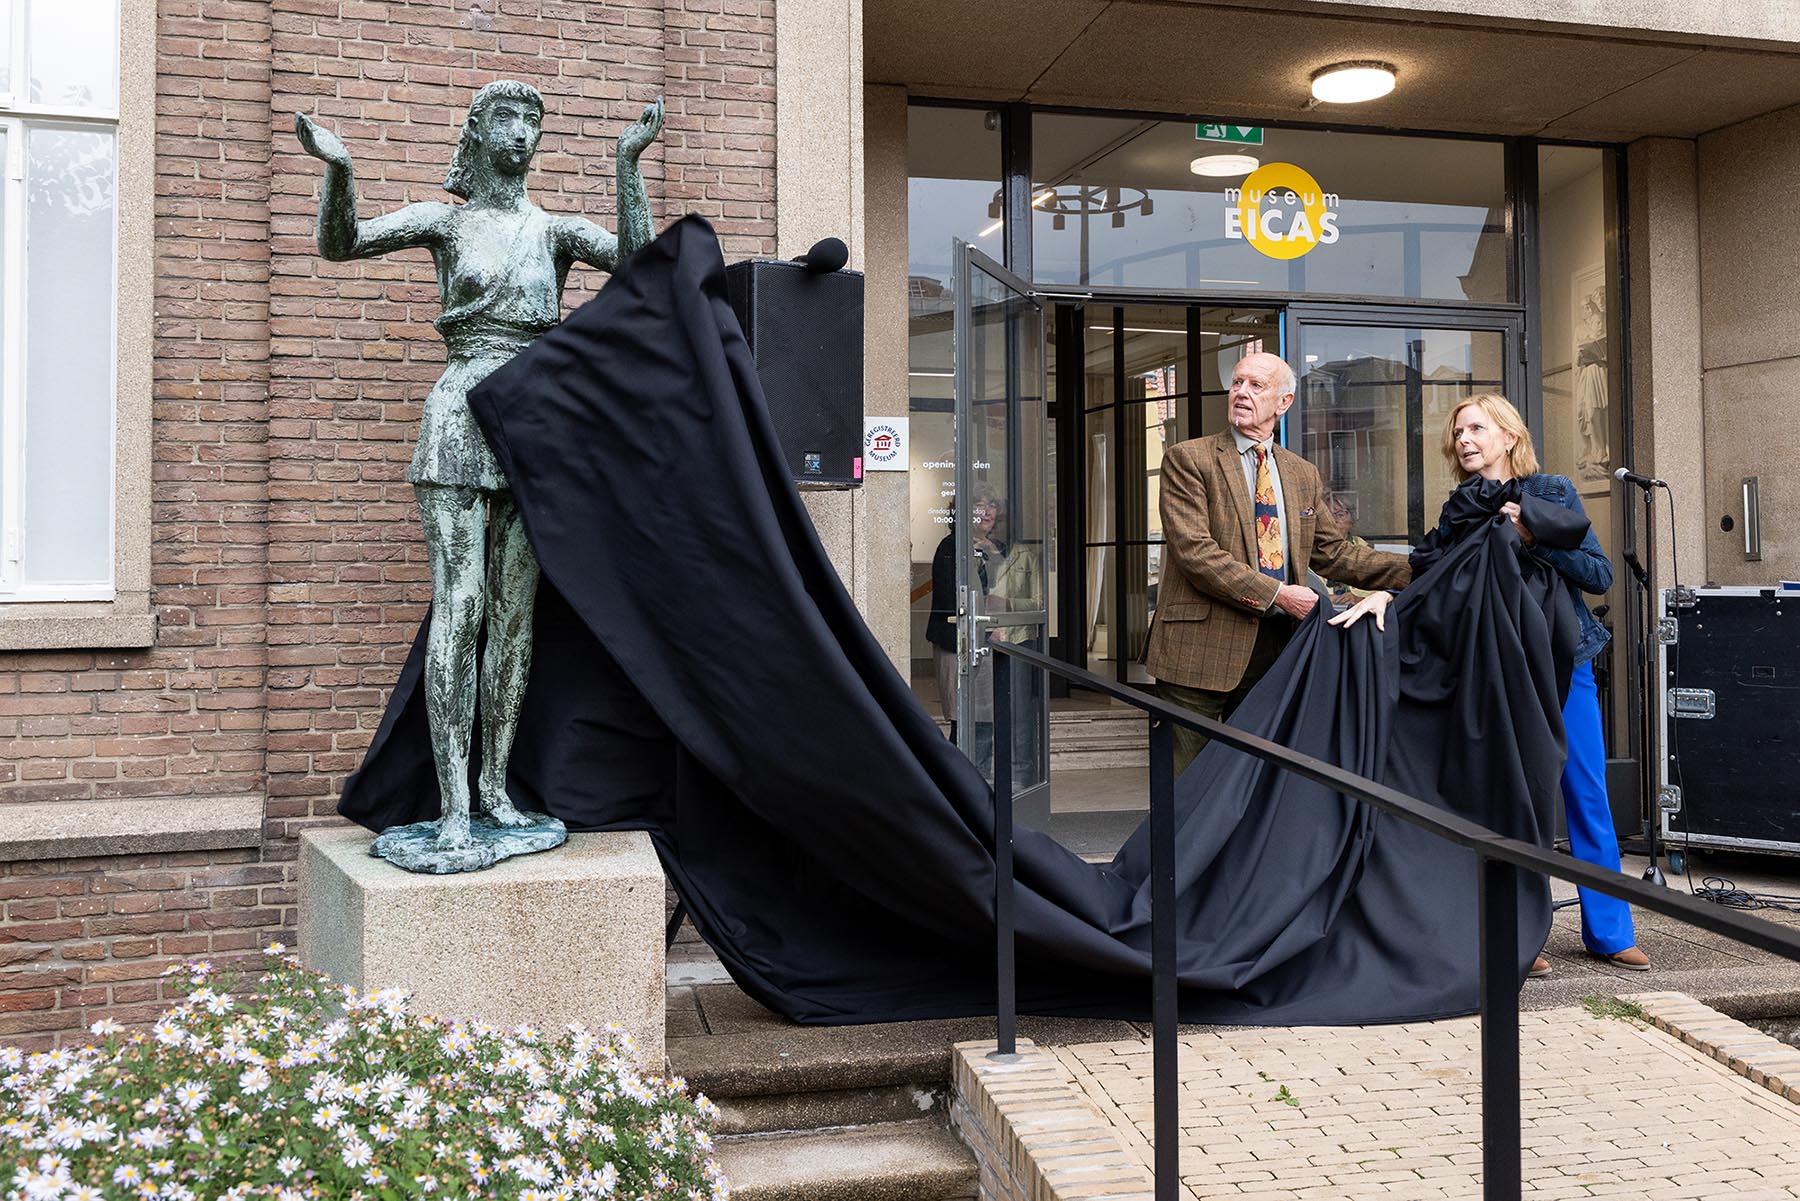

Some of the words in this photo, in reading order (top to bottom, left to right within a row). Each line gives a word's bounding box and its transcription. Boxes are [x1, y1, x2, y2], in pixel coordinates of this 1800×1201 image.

[1224, 187, 1339, 207] museum
[1224, 207, 1340, 245] EICAS
[864, 425, 901, 447] GEREGISTREERD
[868, 450, 898, 462] MUSEUM
